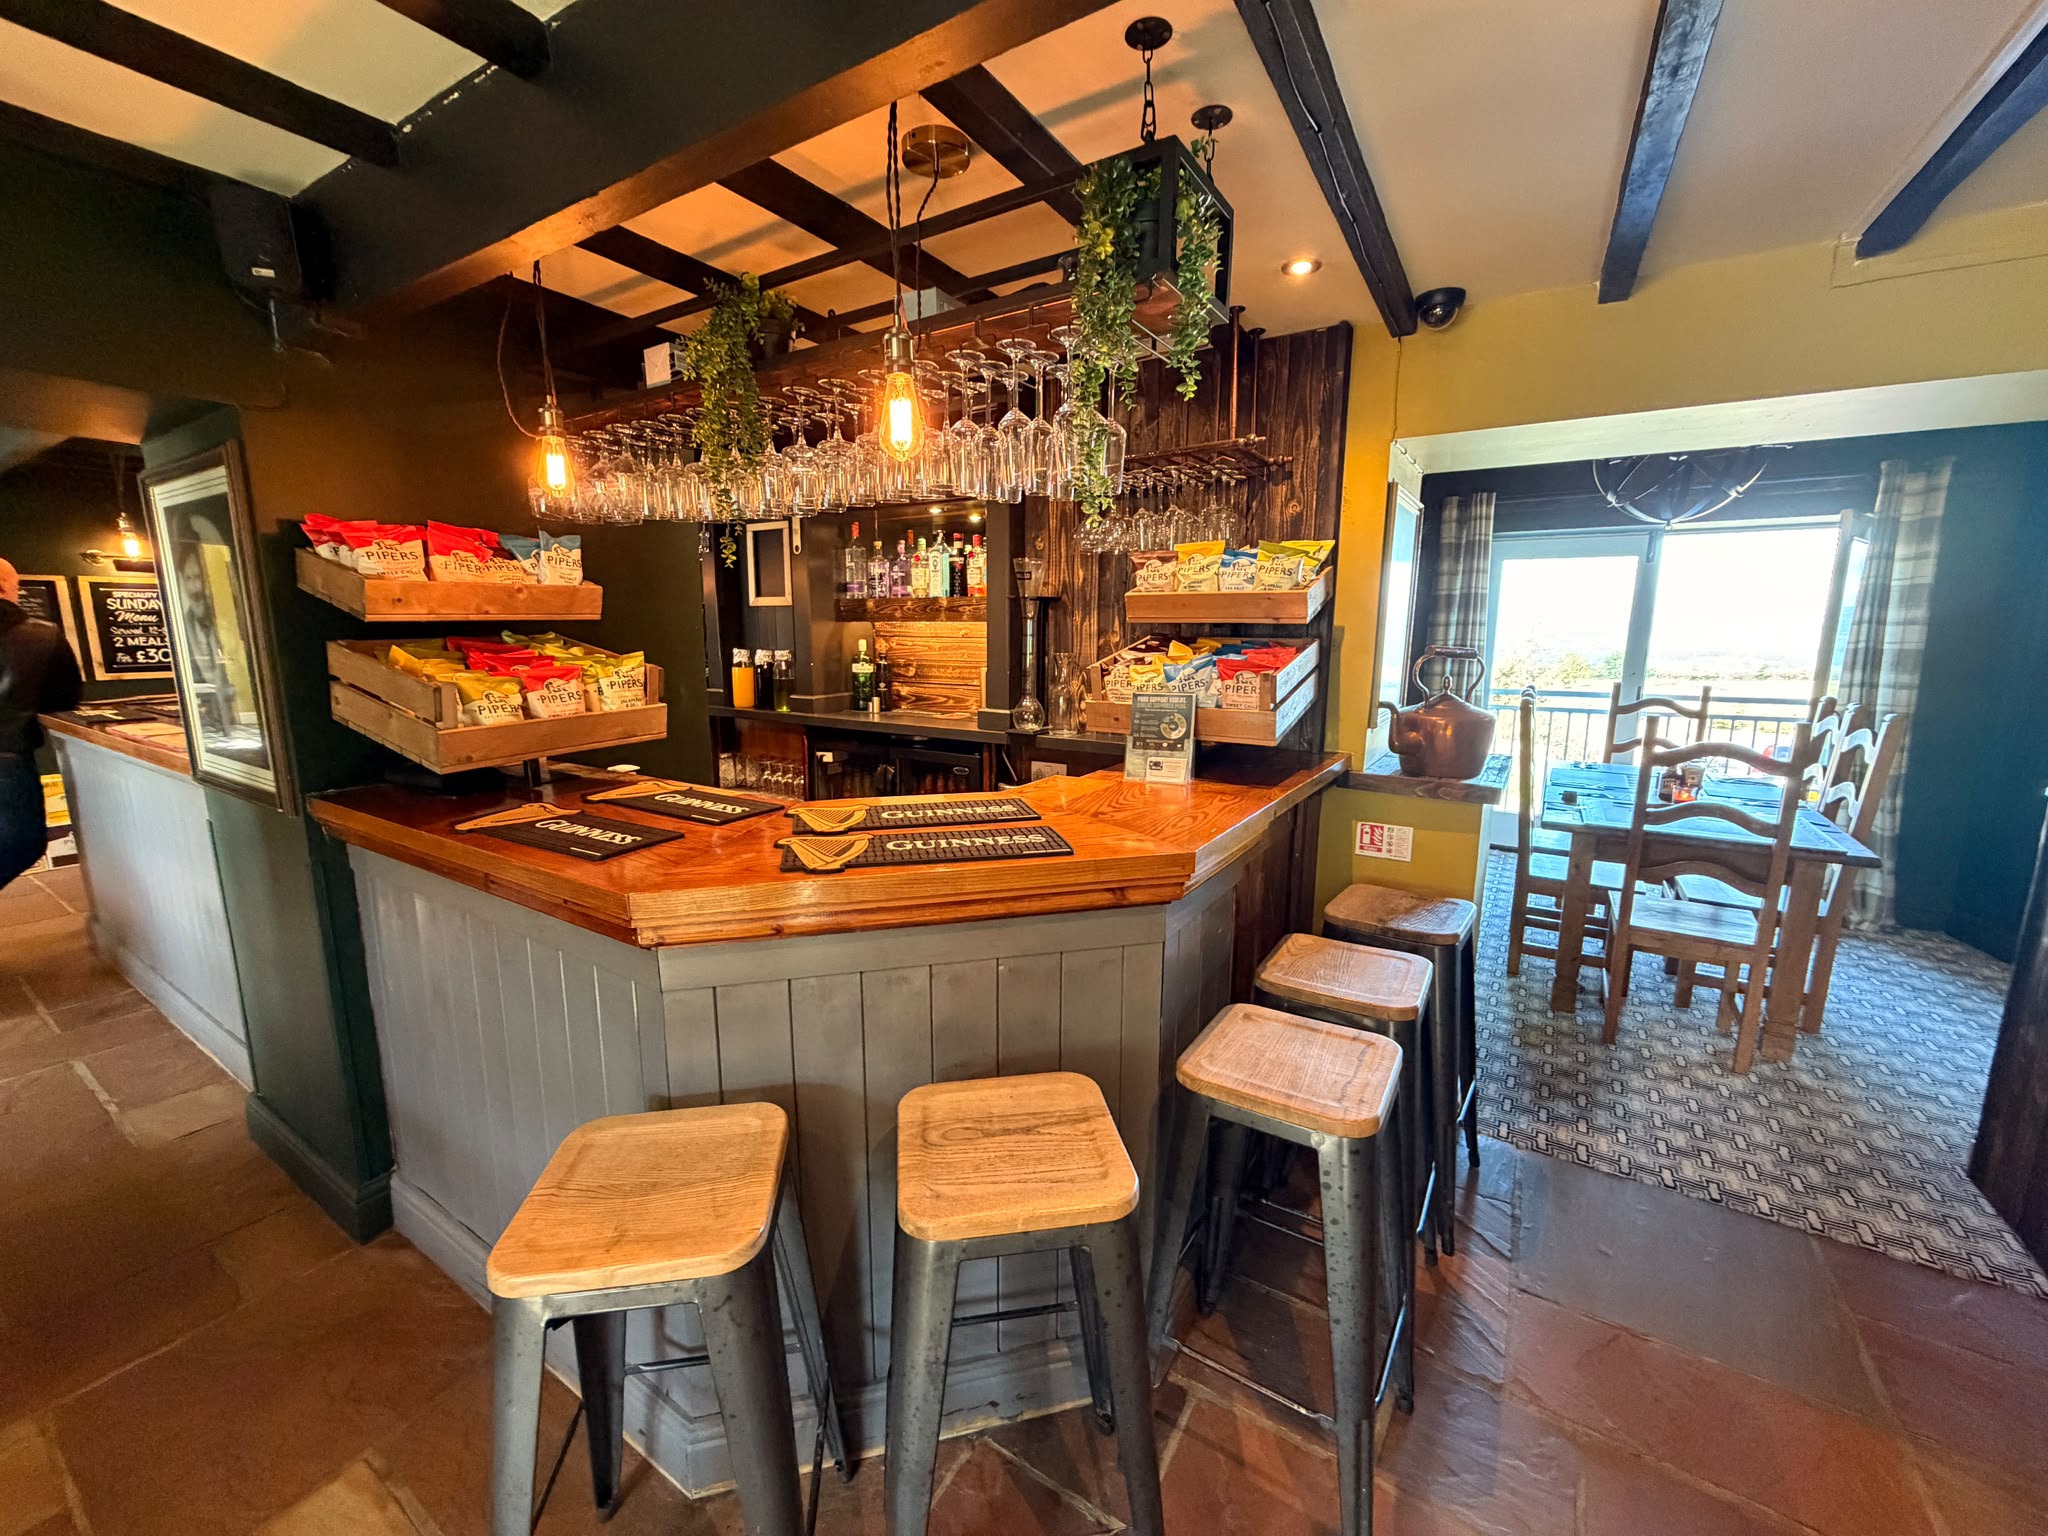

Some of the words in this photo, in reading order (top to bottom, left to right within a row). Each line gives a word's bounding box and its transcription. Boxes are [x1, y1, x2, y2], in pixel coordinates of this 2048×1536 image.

[365, 551, 419, 561] PIPERS
[546, 555, 582, 568] PIPERS
[444, 561, 482, 574] PIPER
[483, 564, 519, 573] PIPER
[1178, 564, 1211, 574] PIPERS
[1258, 565, 1294, 577] PIPERS
[1138, 572, 1169, 582] PIPERS
[1220, 571, 1256, 580] PIPERS
[113, 637, 125, 647] 2
[136, 648, 171, 663] £30
[609, 678, 644, 690] PIPERS
[1106, 679, 1132, 688] PIPER
[1225, 684, 1260, 695] PIPER
[540, 690, 582, 704] PIPERS
[654, 793, 749, 814] GUINNESS
[881, 804, 1017, 819] GUINNESS
[535, 819, 642, 845] GUINNESS
[886, 834, 1046, 851] GUINNESS
